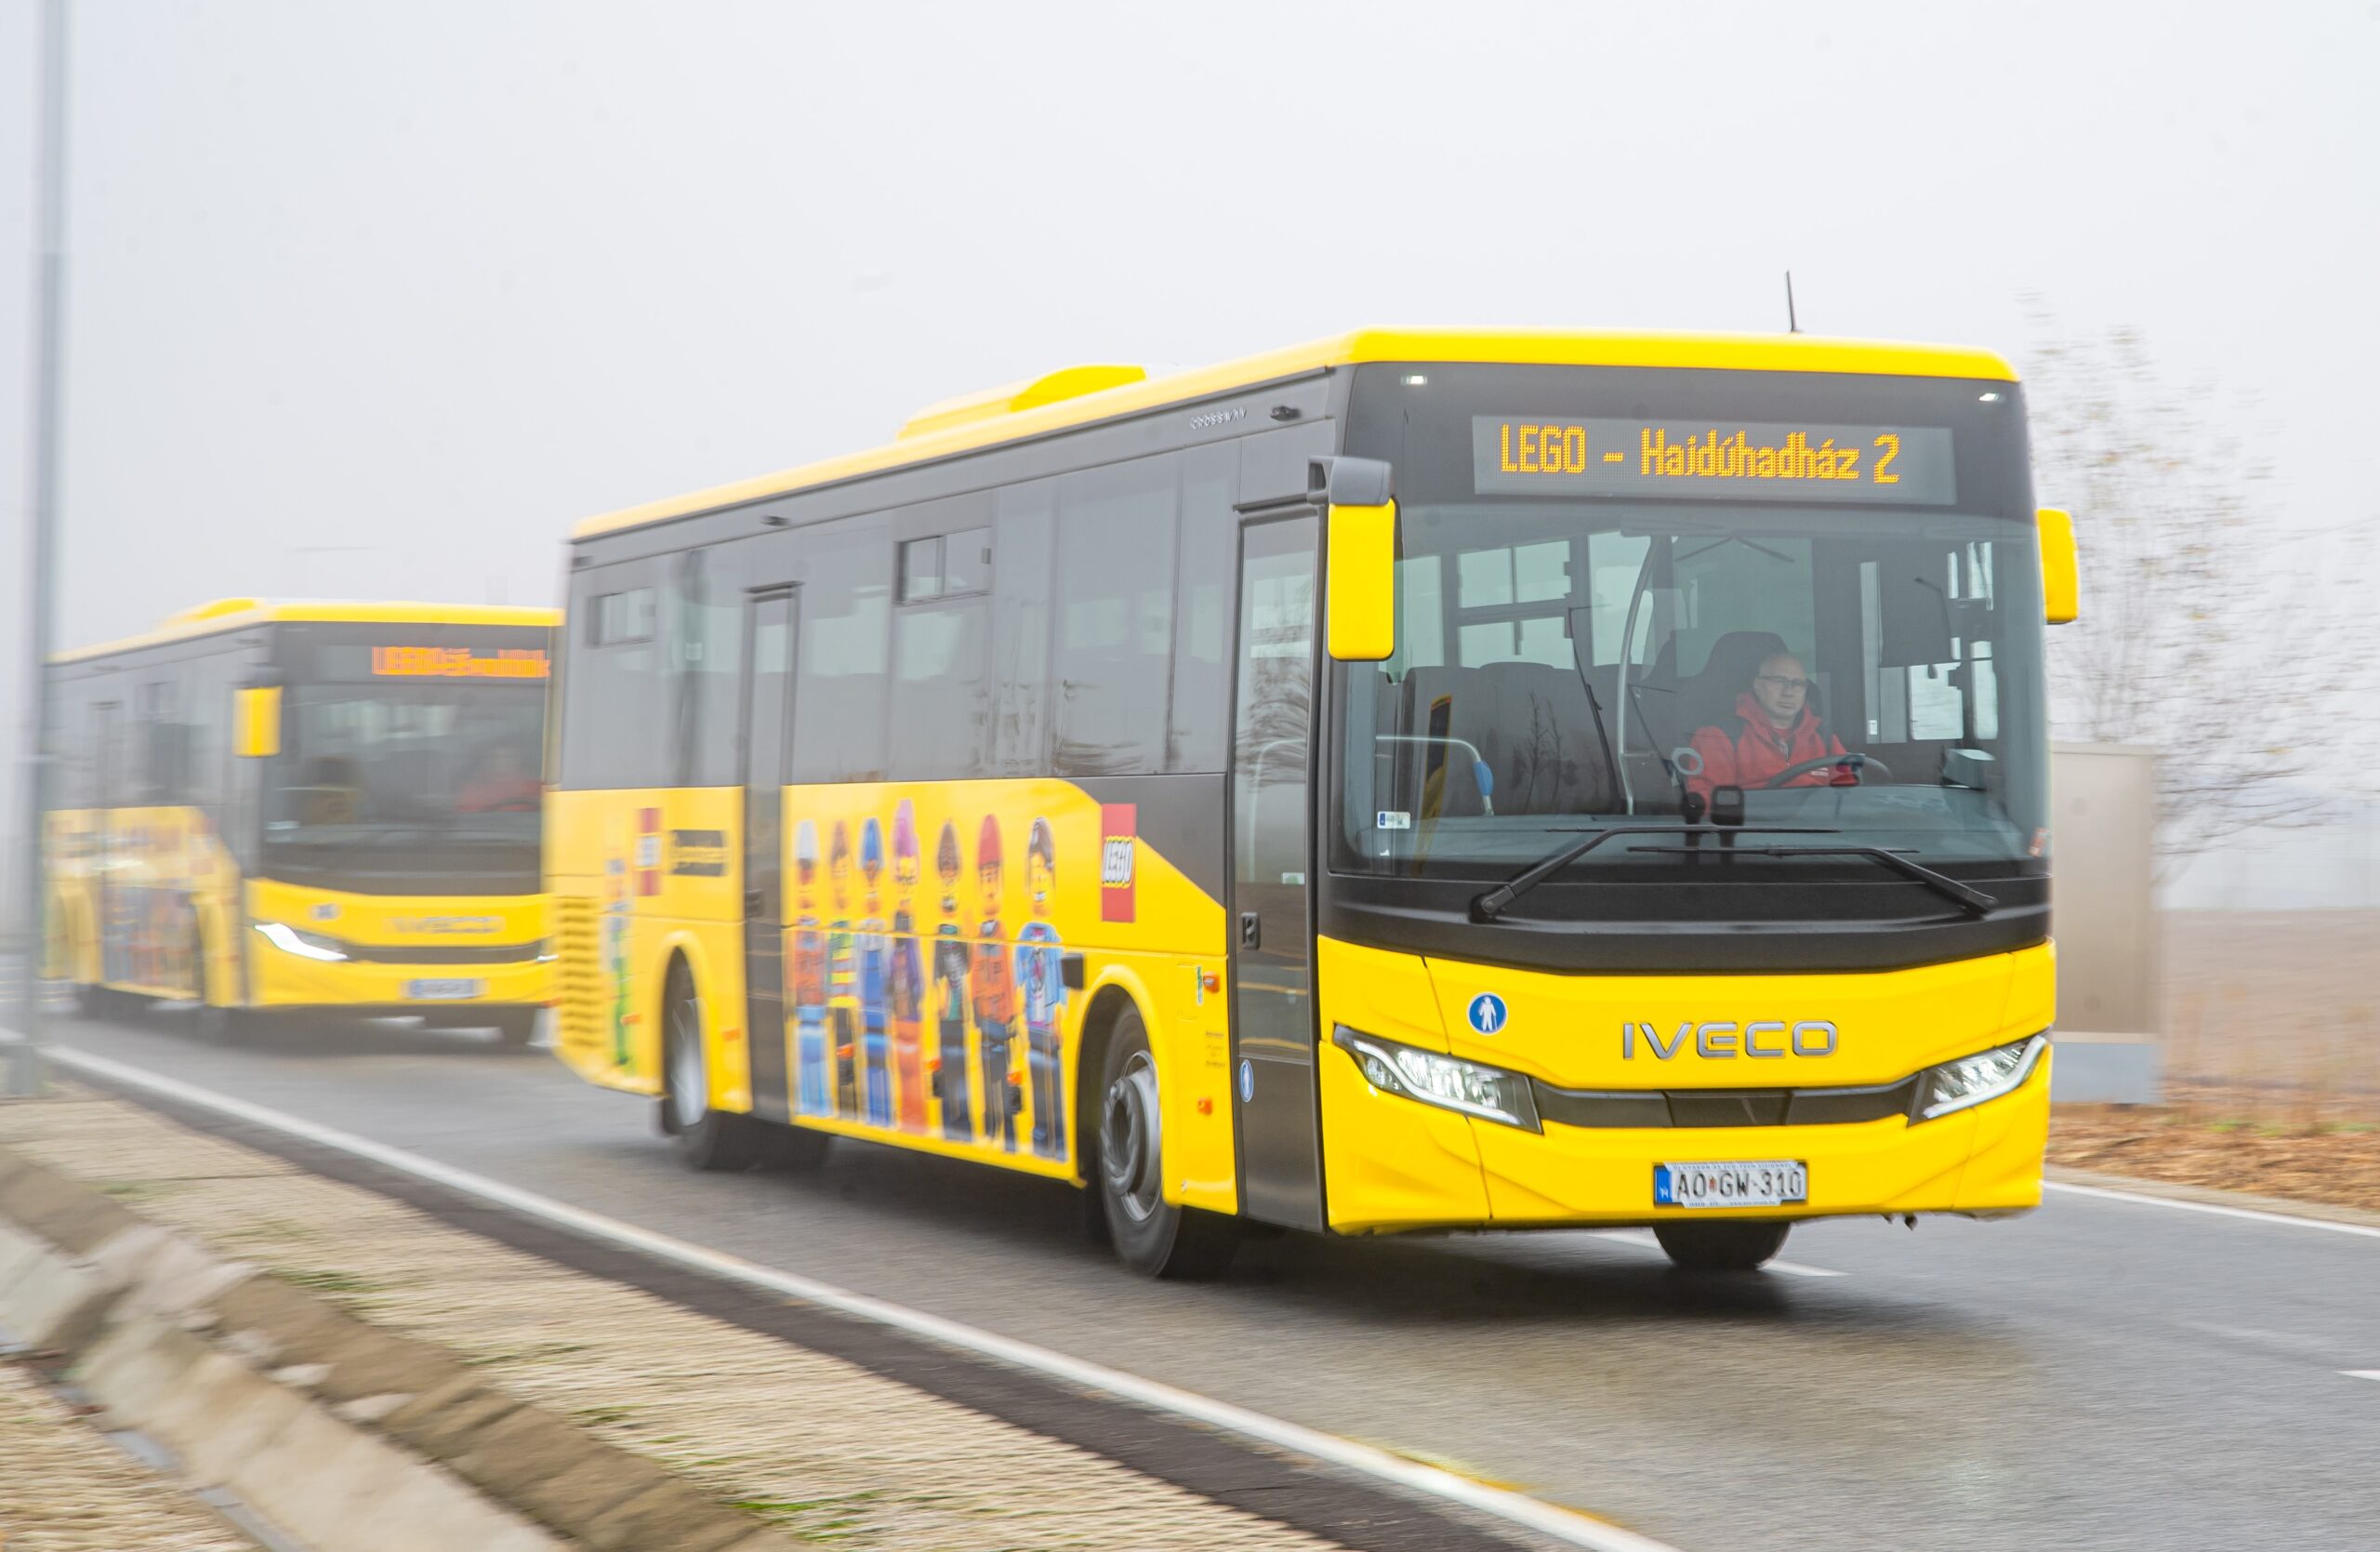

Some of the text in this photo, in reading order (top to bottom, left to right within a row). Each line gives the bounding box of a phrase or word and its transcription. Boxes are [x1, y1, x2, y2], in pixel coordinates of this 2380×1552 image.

[1501, 424, 1900, 484] LEGO - Hajdúhadház 2
[1103, 837, 1134, 888] LEGO
[1622, 1020, 1838, 1060] IVECO
[1677, 1171, 1802, 1199] AO GW-310
